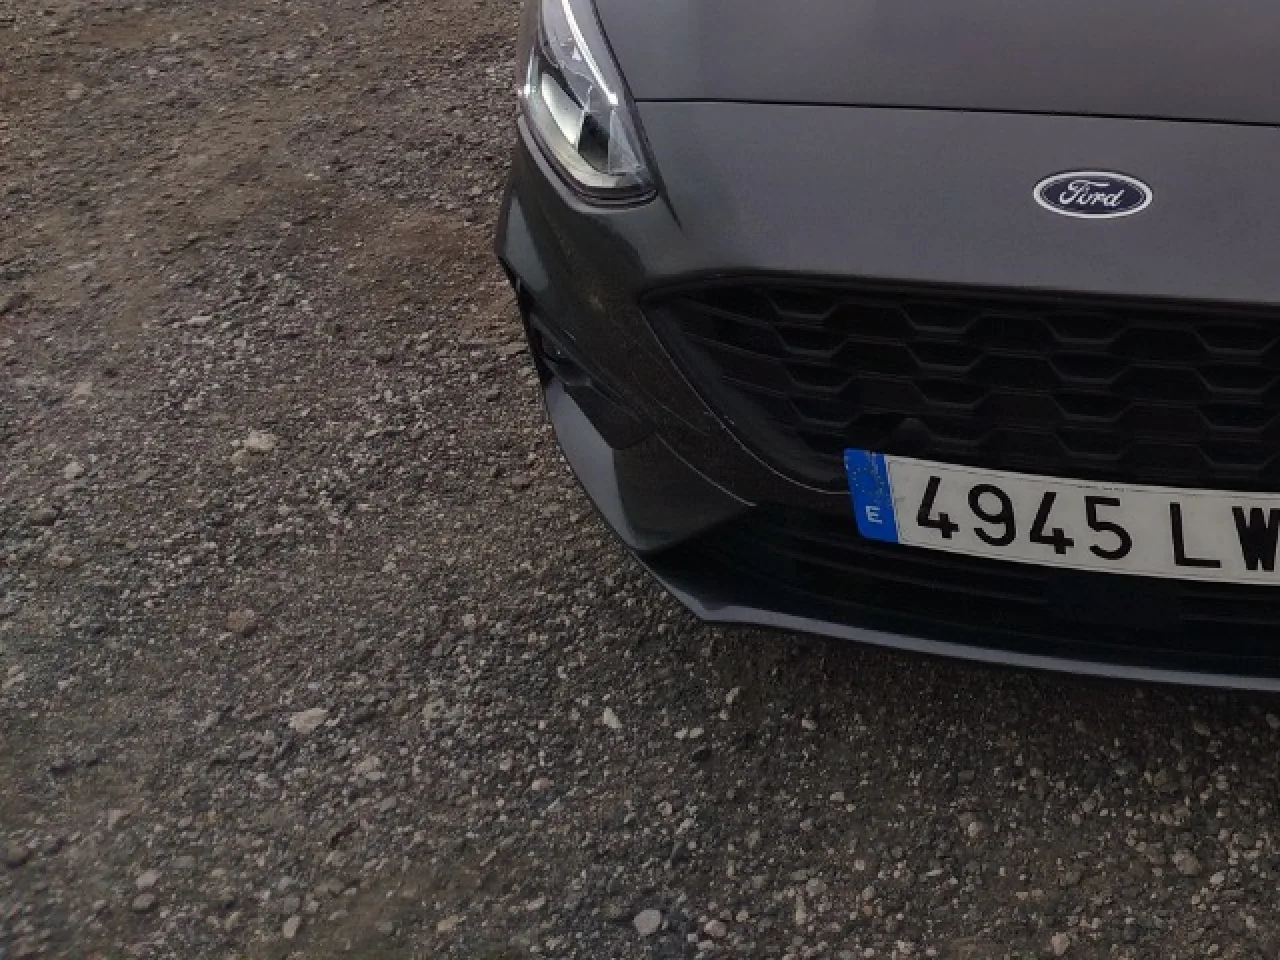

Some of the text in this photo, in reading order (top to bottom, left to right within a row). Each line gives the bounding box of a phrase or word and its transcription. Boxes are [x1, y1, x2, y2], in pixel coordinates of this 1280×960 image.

[1059, 179, 1125, 207] Ford
[865, 504, 883, 525] E
[915, 475, 1133, 561] 4945
